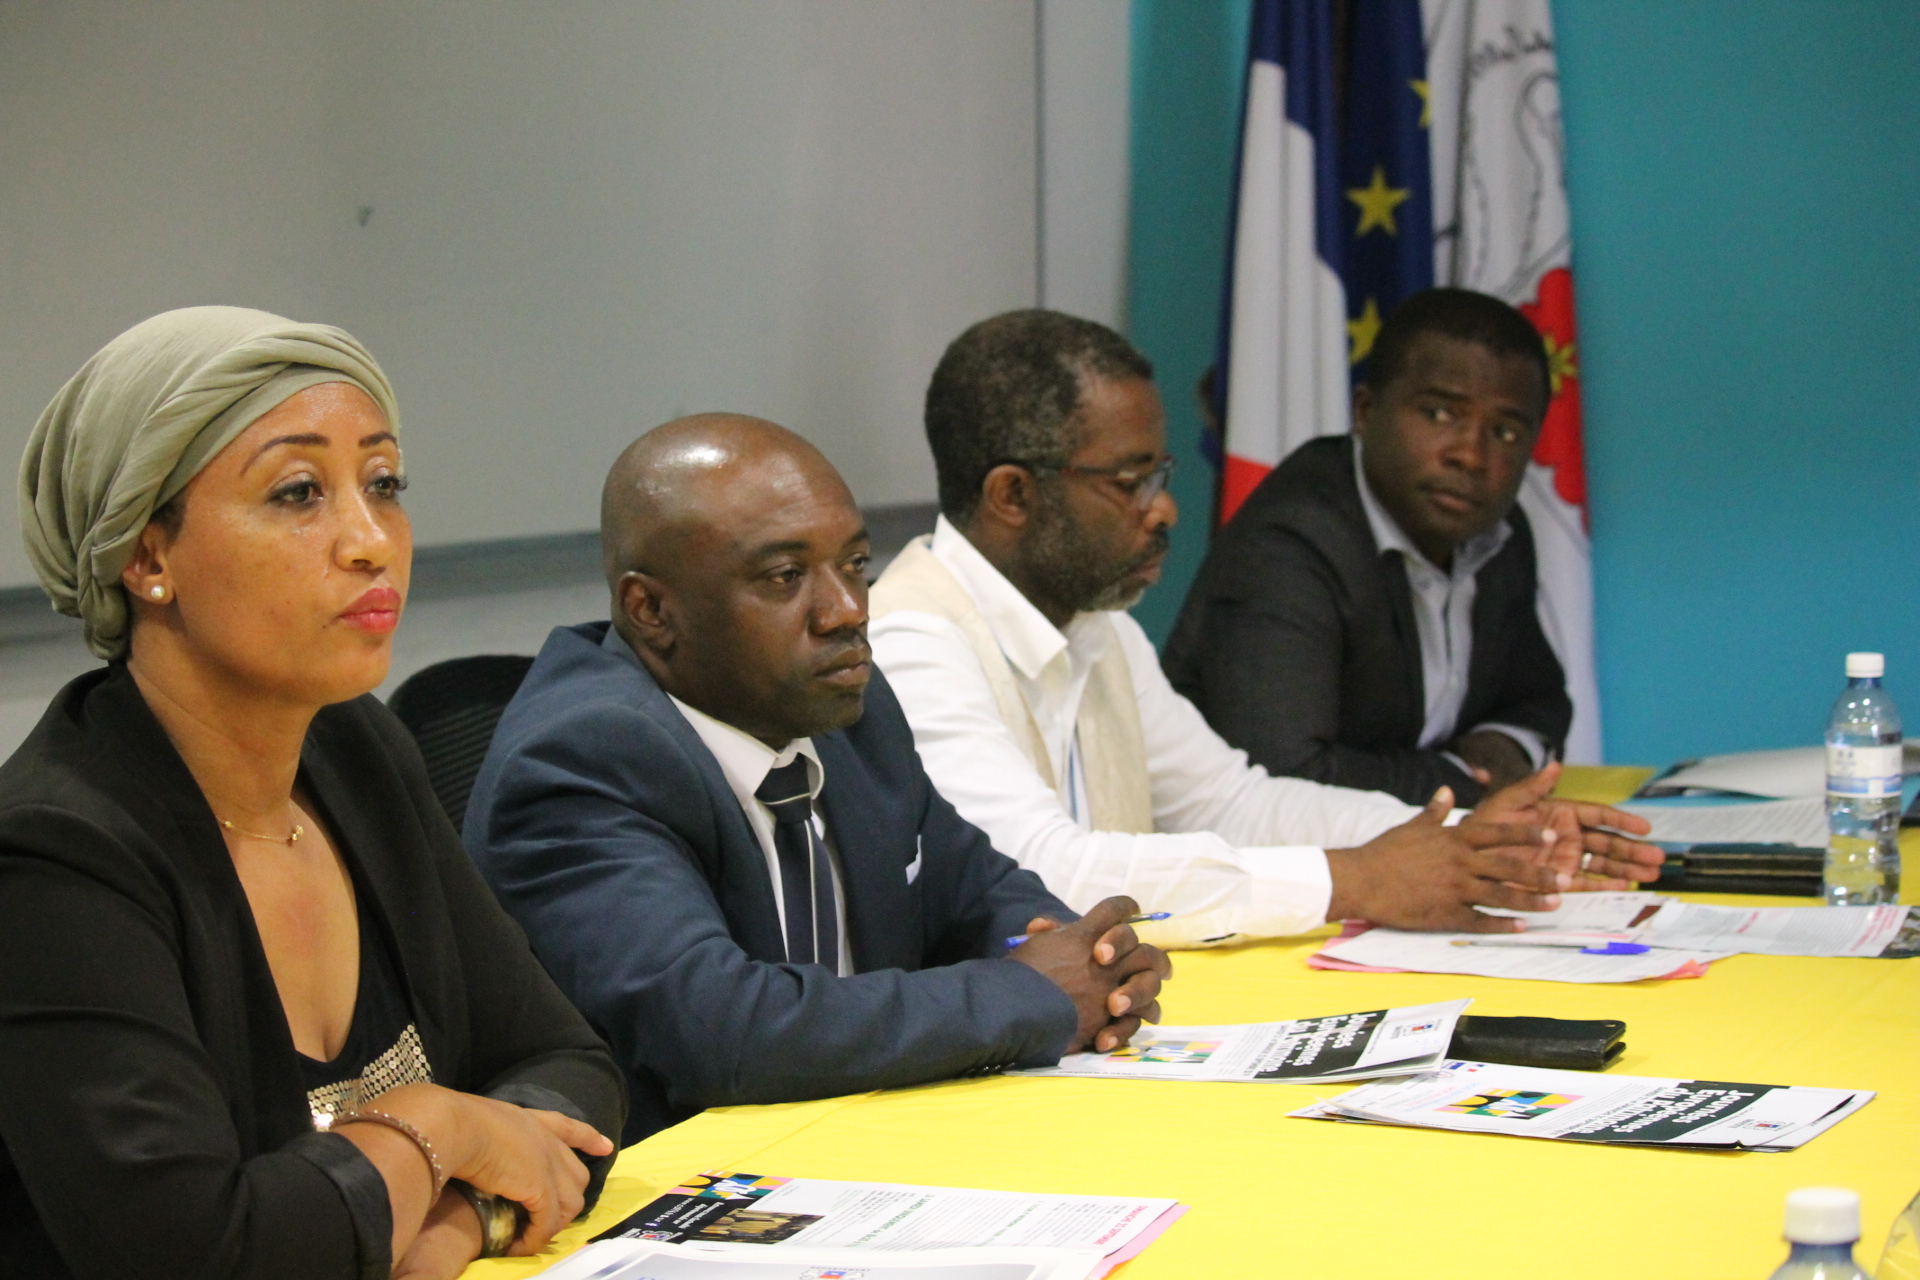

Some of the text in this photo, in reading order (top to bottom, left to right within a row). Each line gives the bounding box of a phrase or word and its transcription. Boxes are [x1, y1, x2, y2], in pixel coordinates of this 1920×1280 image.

[1572, 1099, 1675, 1133] Patrimoine
[1612, 1089, 1727, 1133] Européennes
[1671, 1089, 1755, 1123] Journées
